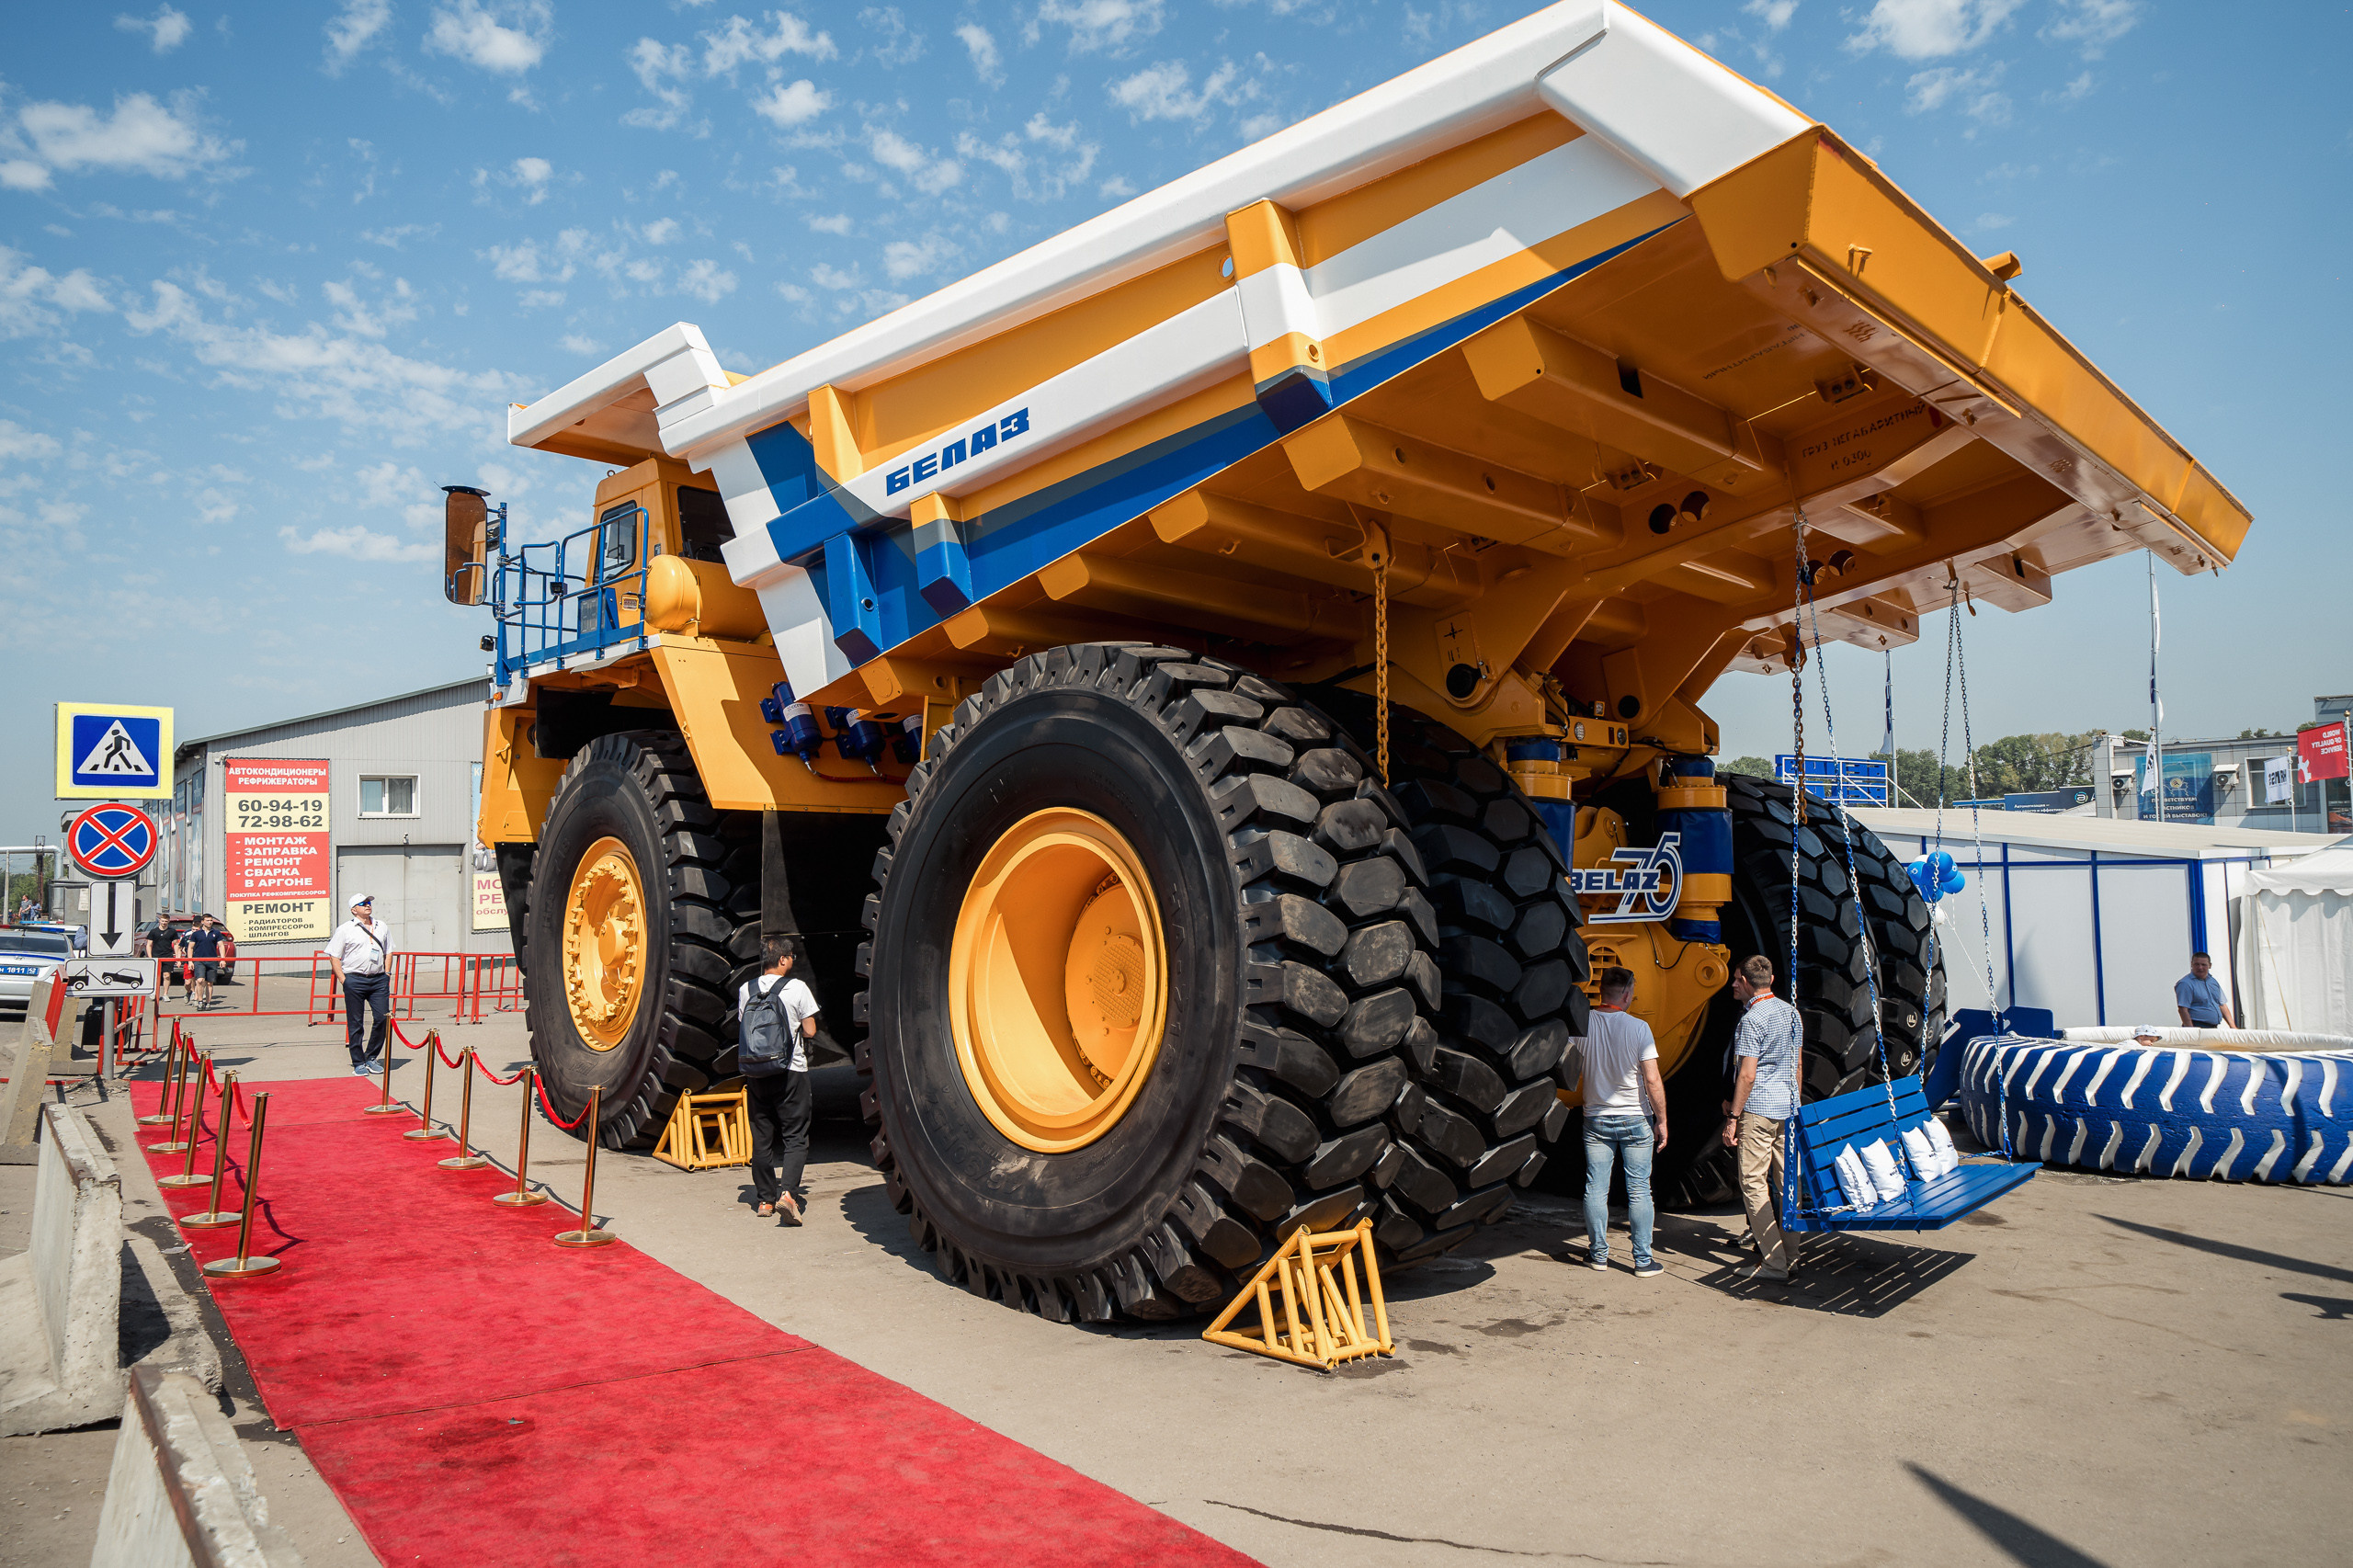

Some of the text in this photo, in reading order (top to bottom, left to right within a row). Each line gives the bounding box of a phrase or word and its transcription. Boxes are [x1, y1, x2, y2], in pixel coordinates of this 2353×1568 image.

[886, 407, 1029, 496] БЕЛАЗ
[229, 767, 326, 777] АВТОКОНДИЦИОНЕРЫ
[238, 778, 318, 786] РЕФРИЖЕРАТОРЫ
[238, 800, 323, 812] 60-94-19
[238, 815, 323, 827] 72-98-62
[244, 836, 307, 846] МОНТАЖ
[244, 846, 317, 856] ЗАПРАВКА
[244, 858, 302, 867] РЕМОНТ
[244, 868, 300, 877] СВАРКА
[244, 878, 313, 888] В АРГОНЕ
[1571, 869, 1661, 894] BELAZ
[243, 902, 314, 915] РЕМОНТ
[248, 924, 314, 932] КОМПРЕССОРОВ
